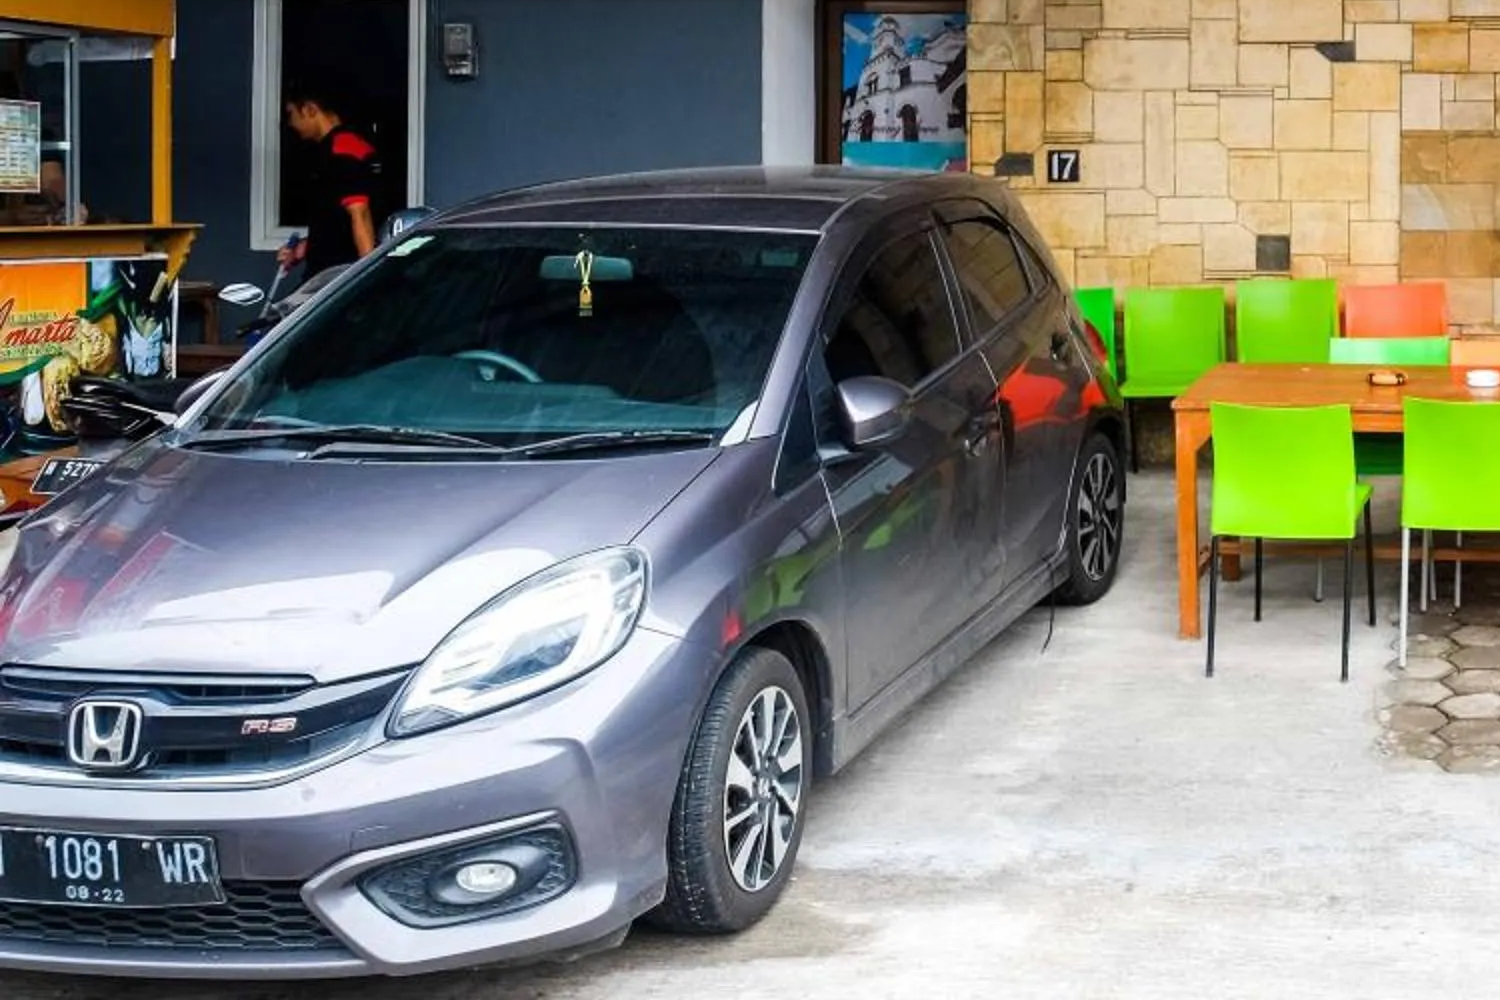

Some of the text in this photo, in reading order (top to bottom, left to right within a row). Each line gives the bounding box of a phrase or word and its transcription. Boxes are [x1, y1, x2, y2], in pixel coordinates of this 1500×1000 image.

[1051, 152, 1077, 180] 17
[45, 835, 120, 882] 1081
[156, 841, 209, 884] WR
